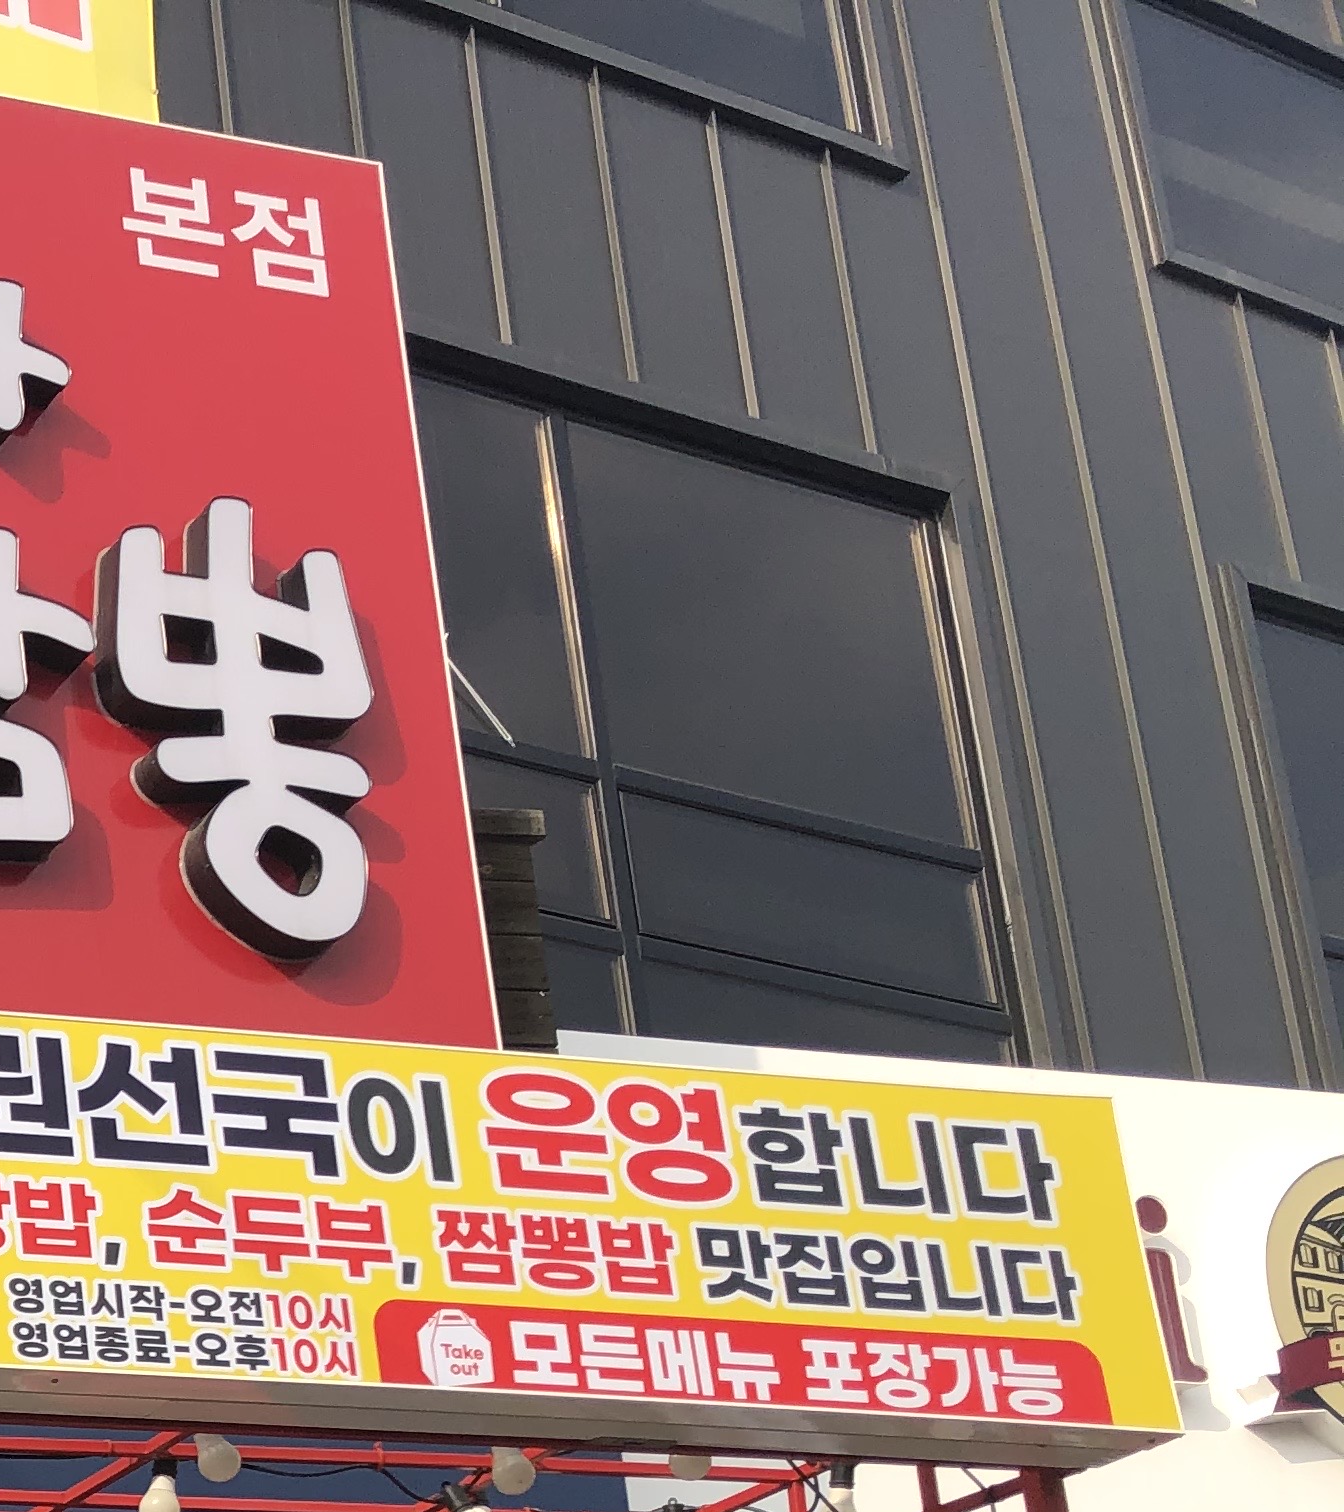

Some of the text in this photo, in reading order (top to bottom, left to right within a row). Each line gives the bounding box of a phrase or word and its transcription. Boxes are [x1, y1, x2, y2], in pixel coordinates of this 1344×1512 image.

[120, 165, 332, 299] 본점
[483, 1071, 1062, 1222] 운영합니다
[147, 1194, 418, 1288] 순두부,
[437, 1209, 675, 1300] 짬뽕밥
[696, 1225, 1078, 1321] 맛집입니다
[9, 1276, 353, 1334] 영업시작-오전10시
[13, 1320, 359, 1378] 영업종료-오후10시
[439, 1342, 485, 1363] Take
[450, 1363, 480, 1379] out
[511, 1322, 1066, 1415] 모든메뉴 포장가능
